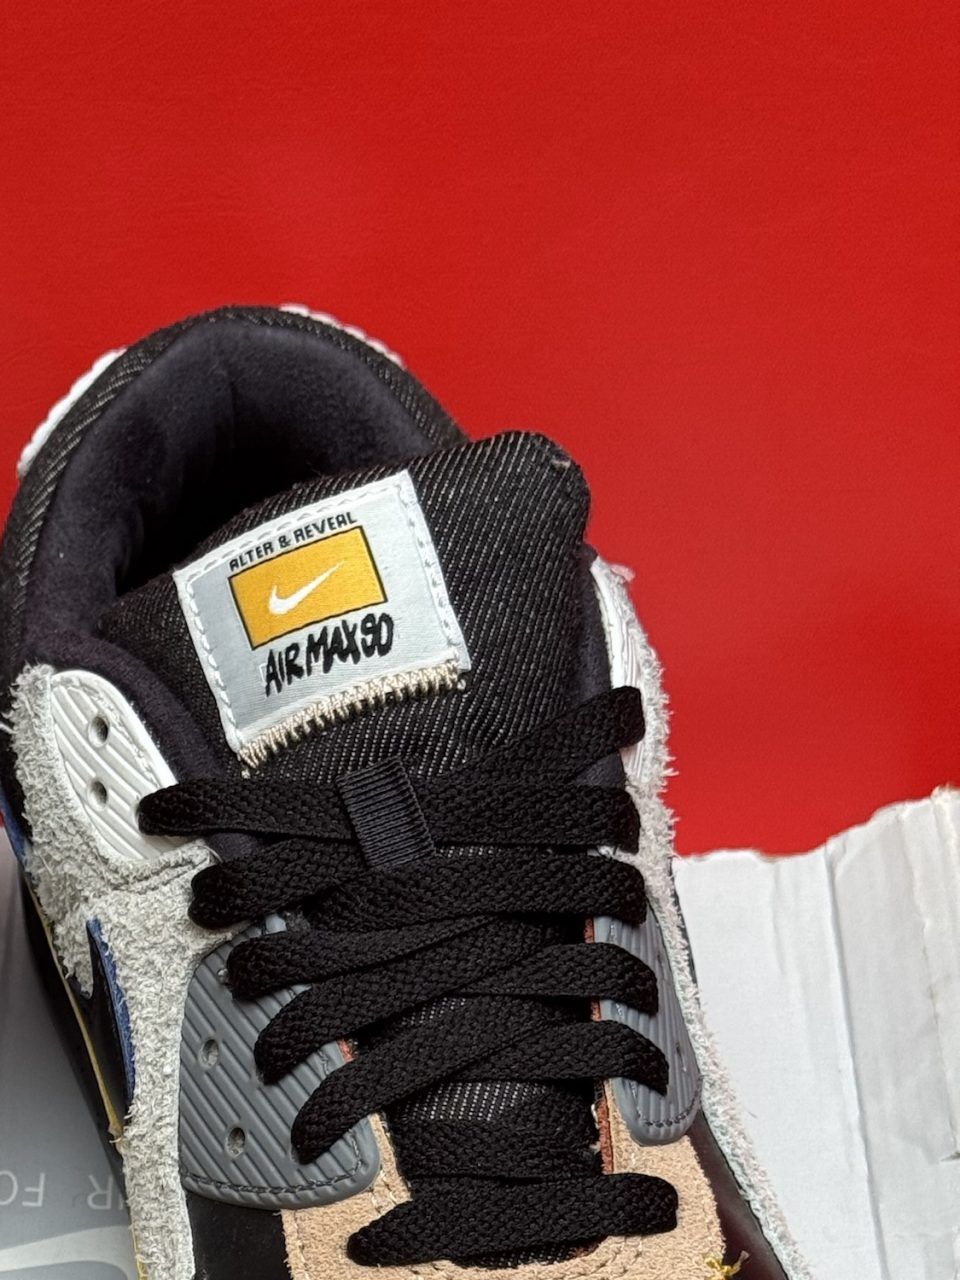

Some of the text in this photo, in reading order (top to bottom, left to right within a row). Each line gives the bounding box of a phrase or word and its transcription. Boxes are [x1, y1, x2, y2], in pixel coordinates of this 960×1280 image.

[229, 512, 357, 571] ALTER & REVEAL
